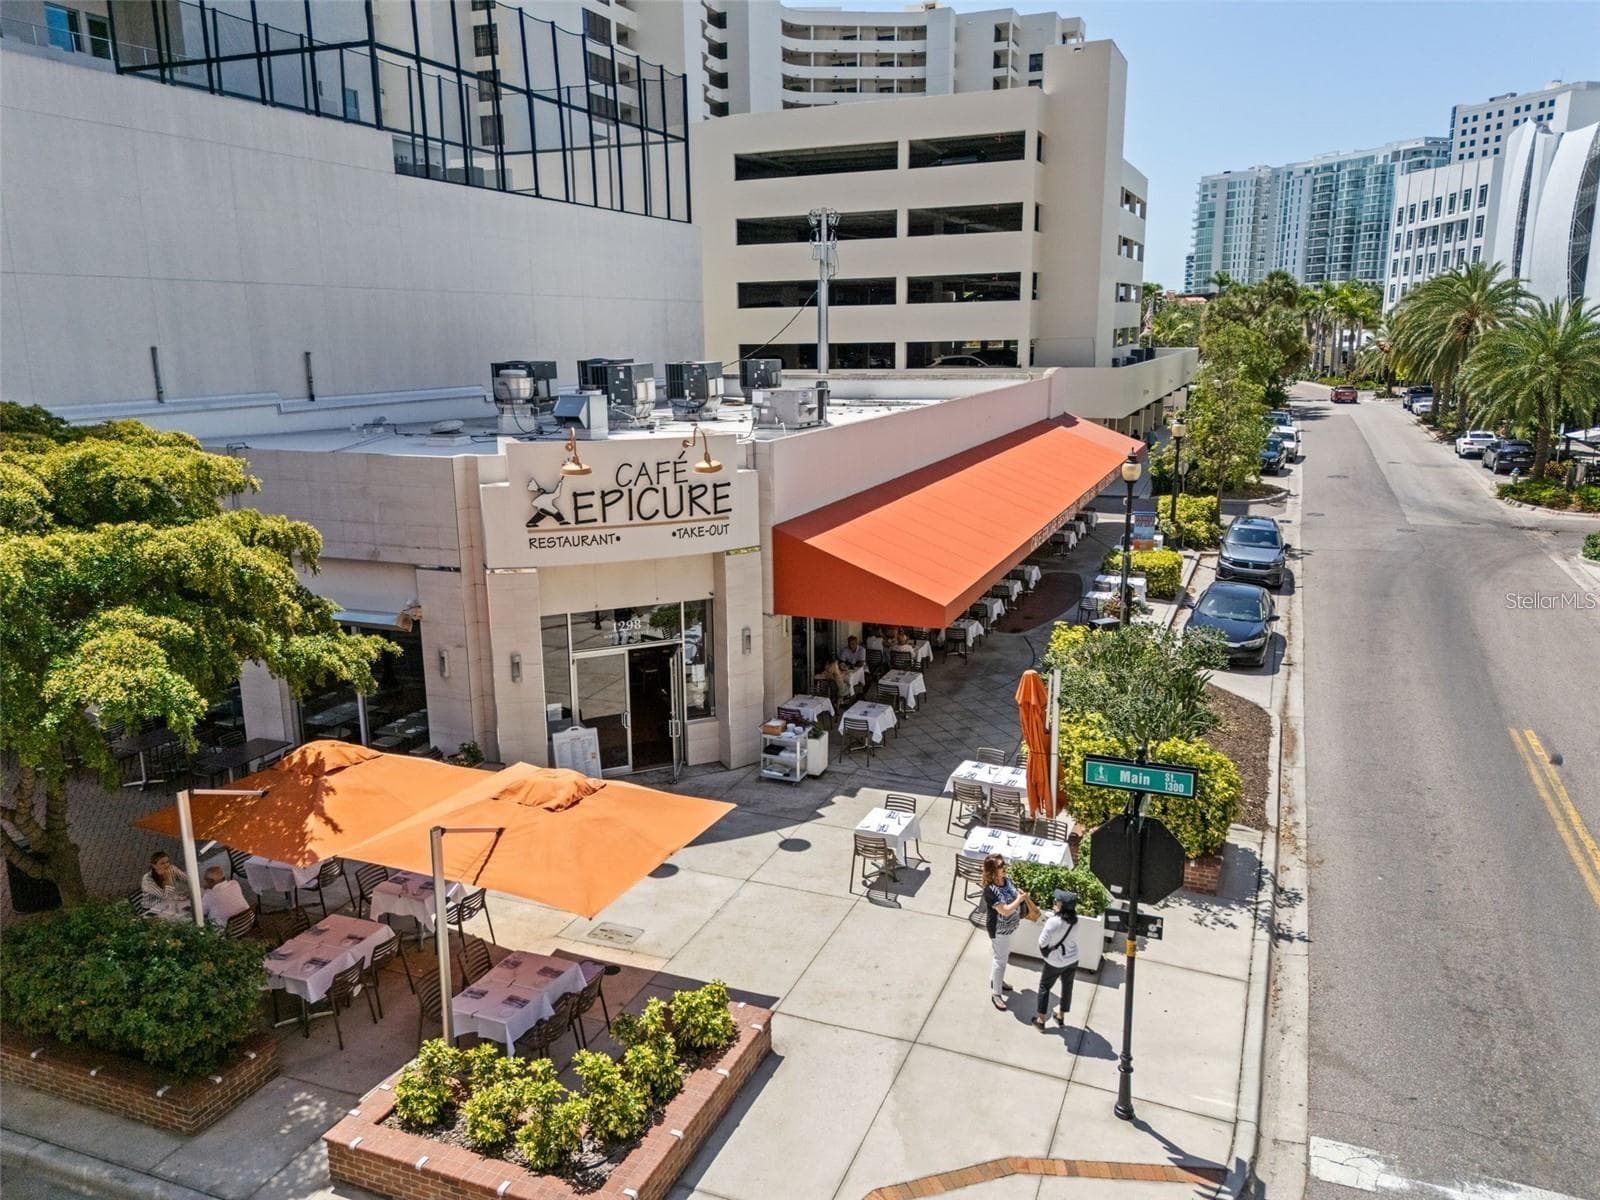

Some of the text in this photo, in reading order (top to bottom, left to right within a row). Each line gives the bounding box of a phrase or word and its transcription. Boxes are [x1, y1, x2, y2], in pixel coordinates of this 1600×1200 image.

[615, 451, 688, 487] CAFÉ
[572, 482, 732, 525] EPICURE
[676, 524, 730, 538] TAKE-OUT
[529, 533, 614, 549] RESTAURANT
[612, 618, 642, 632] 1298
[1120, 770, 1150, 785] Main
[1164, 782, 1184, 792] 1300
